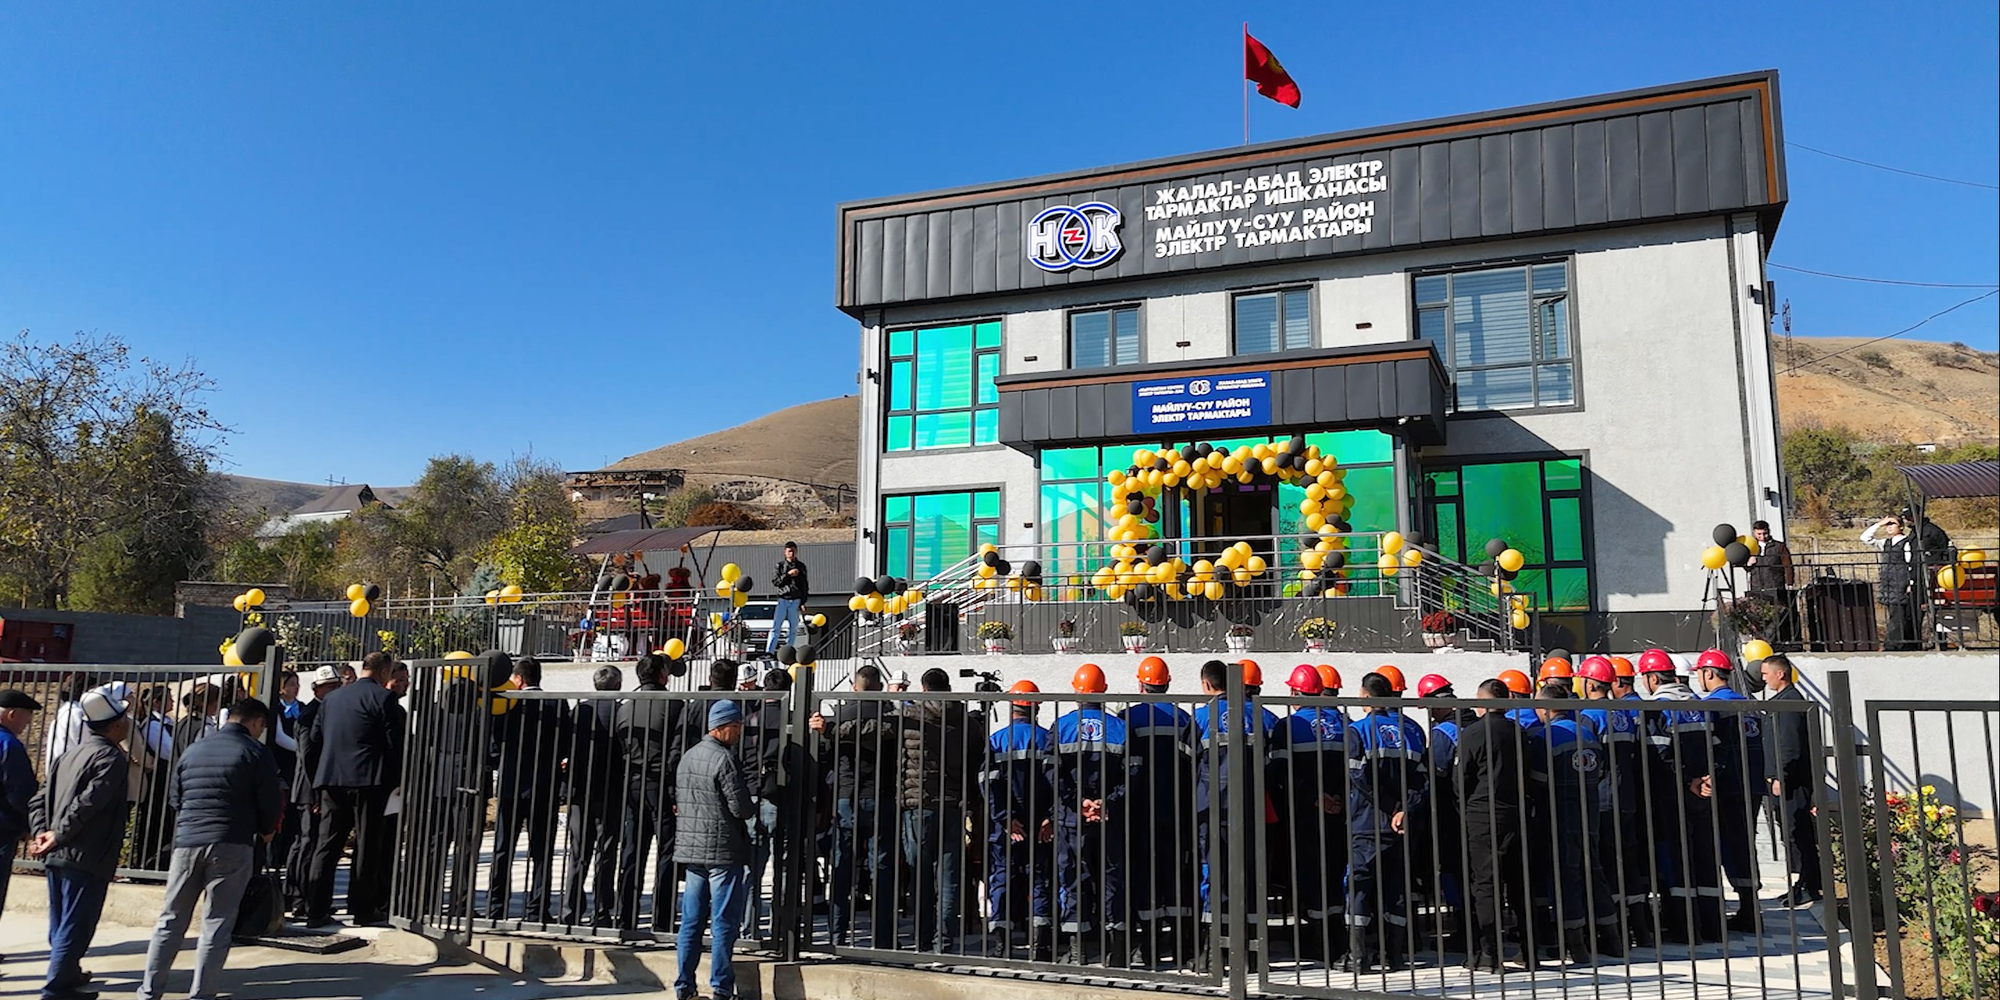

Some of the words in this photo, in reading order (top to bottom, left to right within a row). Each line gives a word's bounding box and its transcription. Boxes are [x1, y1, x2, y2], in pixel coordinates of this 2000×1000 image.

[1145, 193, 1258, 222] ТАРМАКТАР
[1264, 175, 1387, 206] ИШКАНАСЫ
[1155, 170, 1302, 205] ЖАЛАЛ-АБАД
[1308, 159, 1383, 184] ЭЛЕКТР
[1155, 210, 1295, 243] МАЙЛУУ-СУУ
[1302, 200, 1375, 224] РАЙОН
[1155, 235, 1227, 258] ЭЛЕКТР
[1235, 217, 1372, 248] ТАРМАКТАРЫ
[1152, 401, 1214, 413] МАЙЛУУ-СУУ
[1215, 398, 1251, 409] РАЙОН
[1152, 413, 1186, 423] ЭЛЕКТР
[1187, 408, 1251, 420] ТАРМАКТАРЫ
